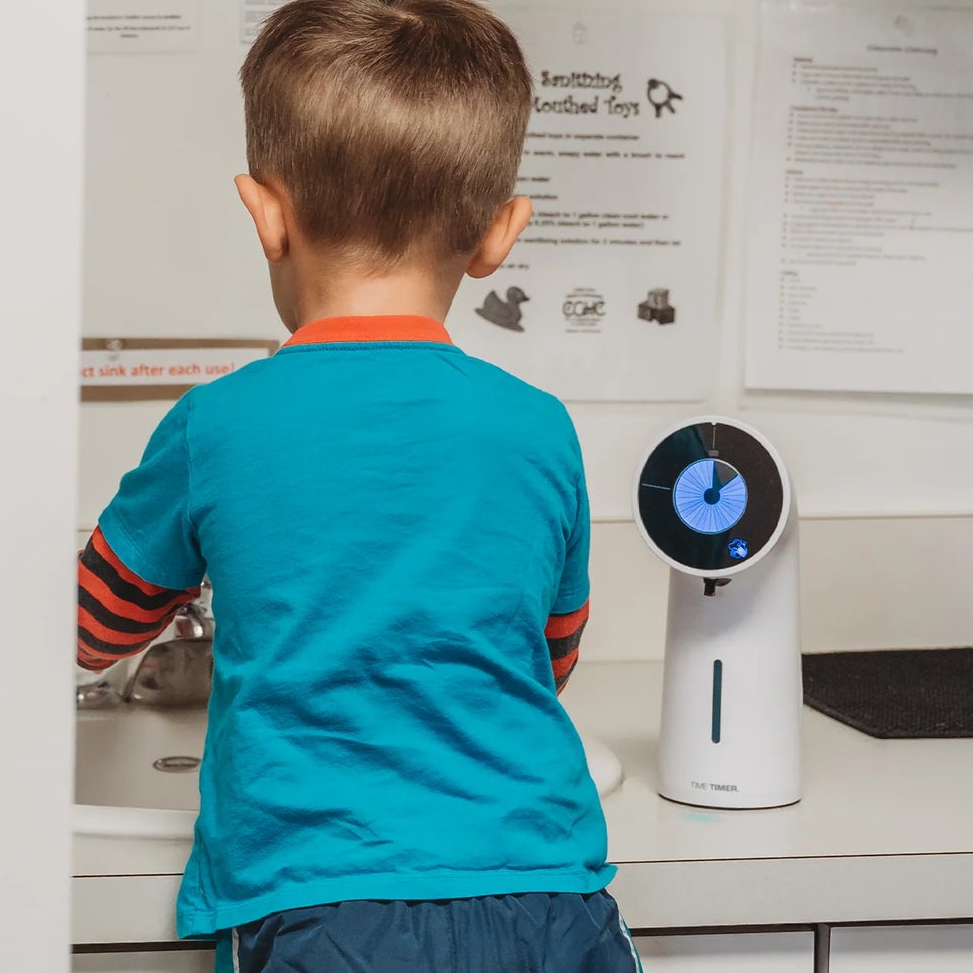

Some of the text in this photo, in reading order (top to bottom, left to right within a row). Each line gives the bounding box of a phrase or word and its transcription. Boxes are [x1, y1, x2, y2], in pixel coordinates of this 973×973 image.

[541, 70, 623, 94] Sanitizing
[604, 94, 640, 119] Toys
[99, 365, 126, 377] sink
[131, 363, 164, 376] after
[168, 362, 201, 375] each
[205, 362, 235, 375] use!
[691, 781, 708, 790] TIME
